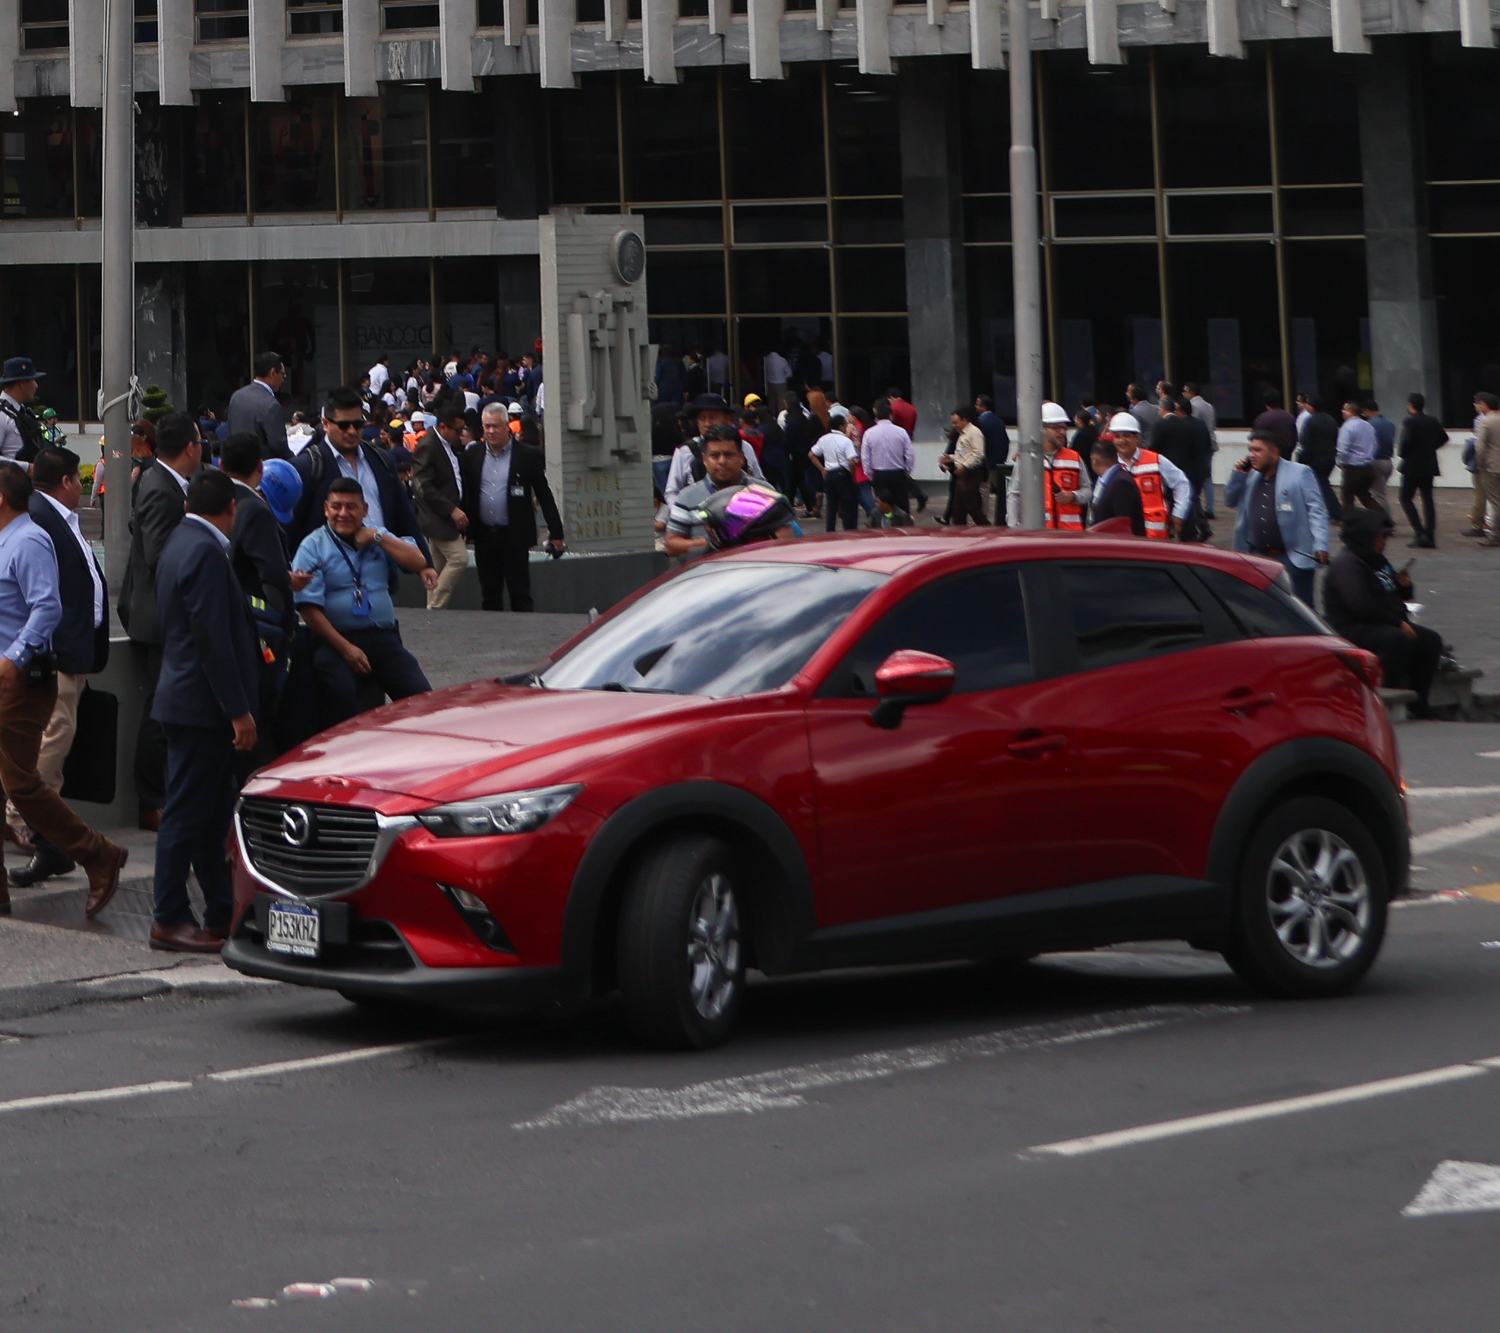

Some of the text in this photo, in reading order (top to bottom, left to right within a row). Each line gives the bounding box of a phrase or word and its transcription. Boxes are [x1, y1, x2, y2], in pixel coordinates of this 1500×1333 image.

[576, 475, 620, 493] PLAZA
[576, 500, 620, 518] CARLOS
[269, 911, 317, 943] P153KHZ
